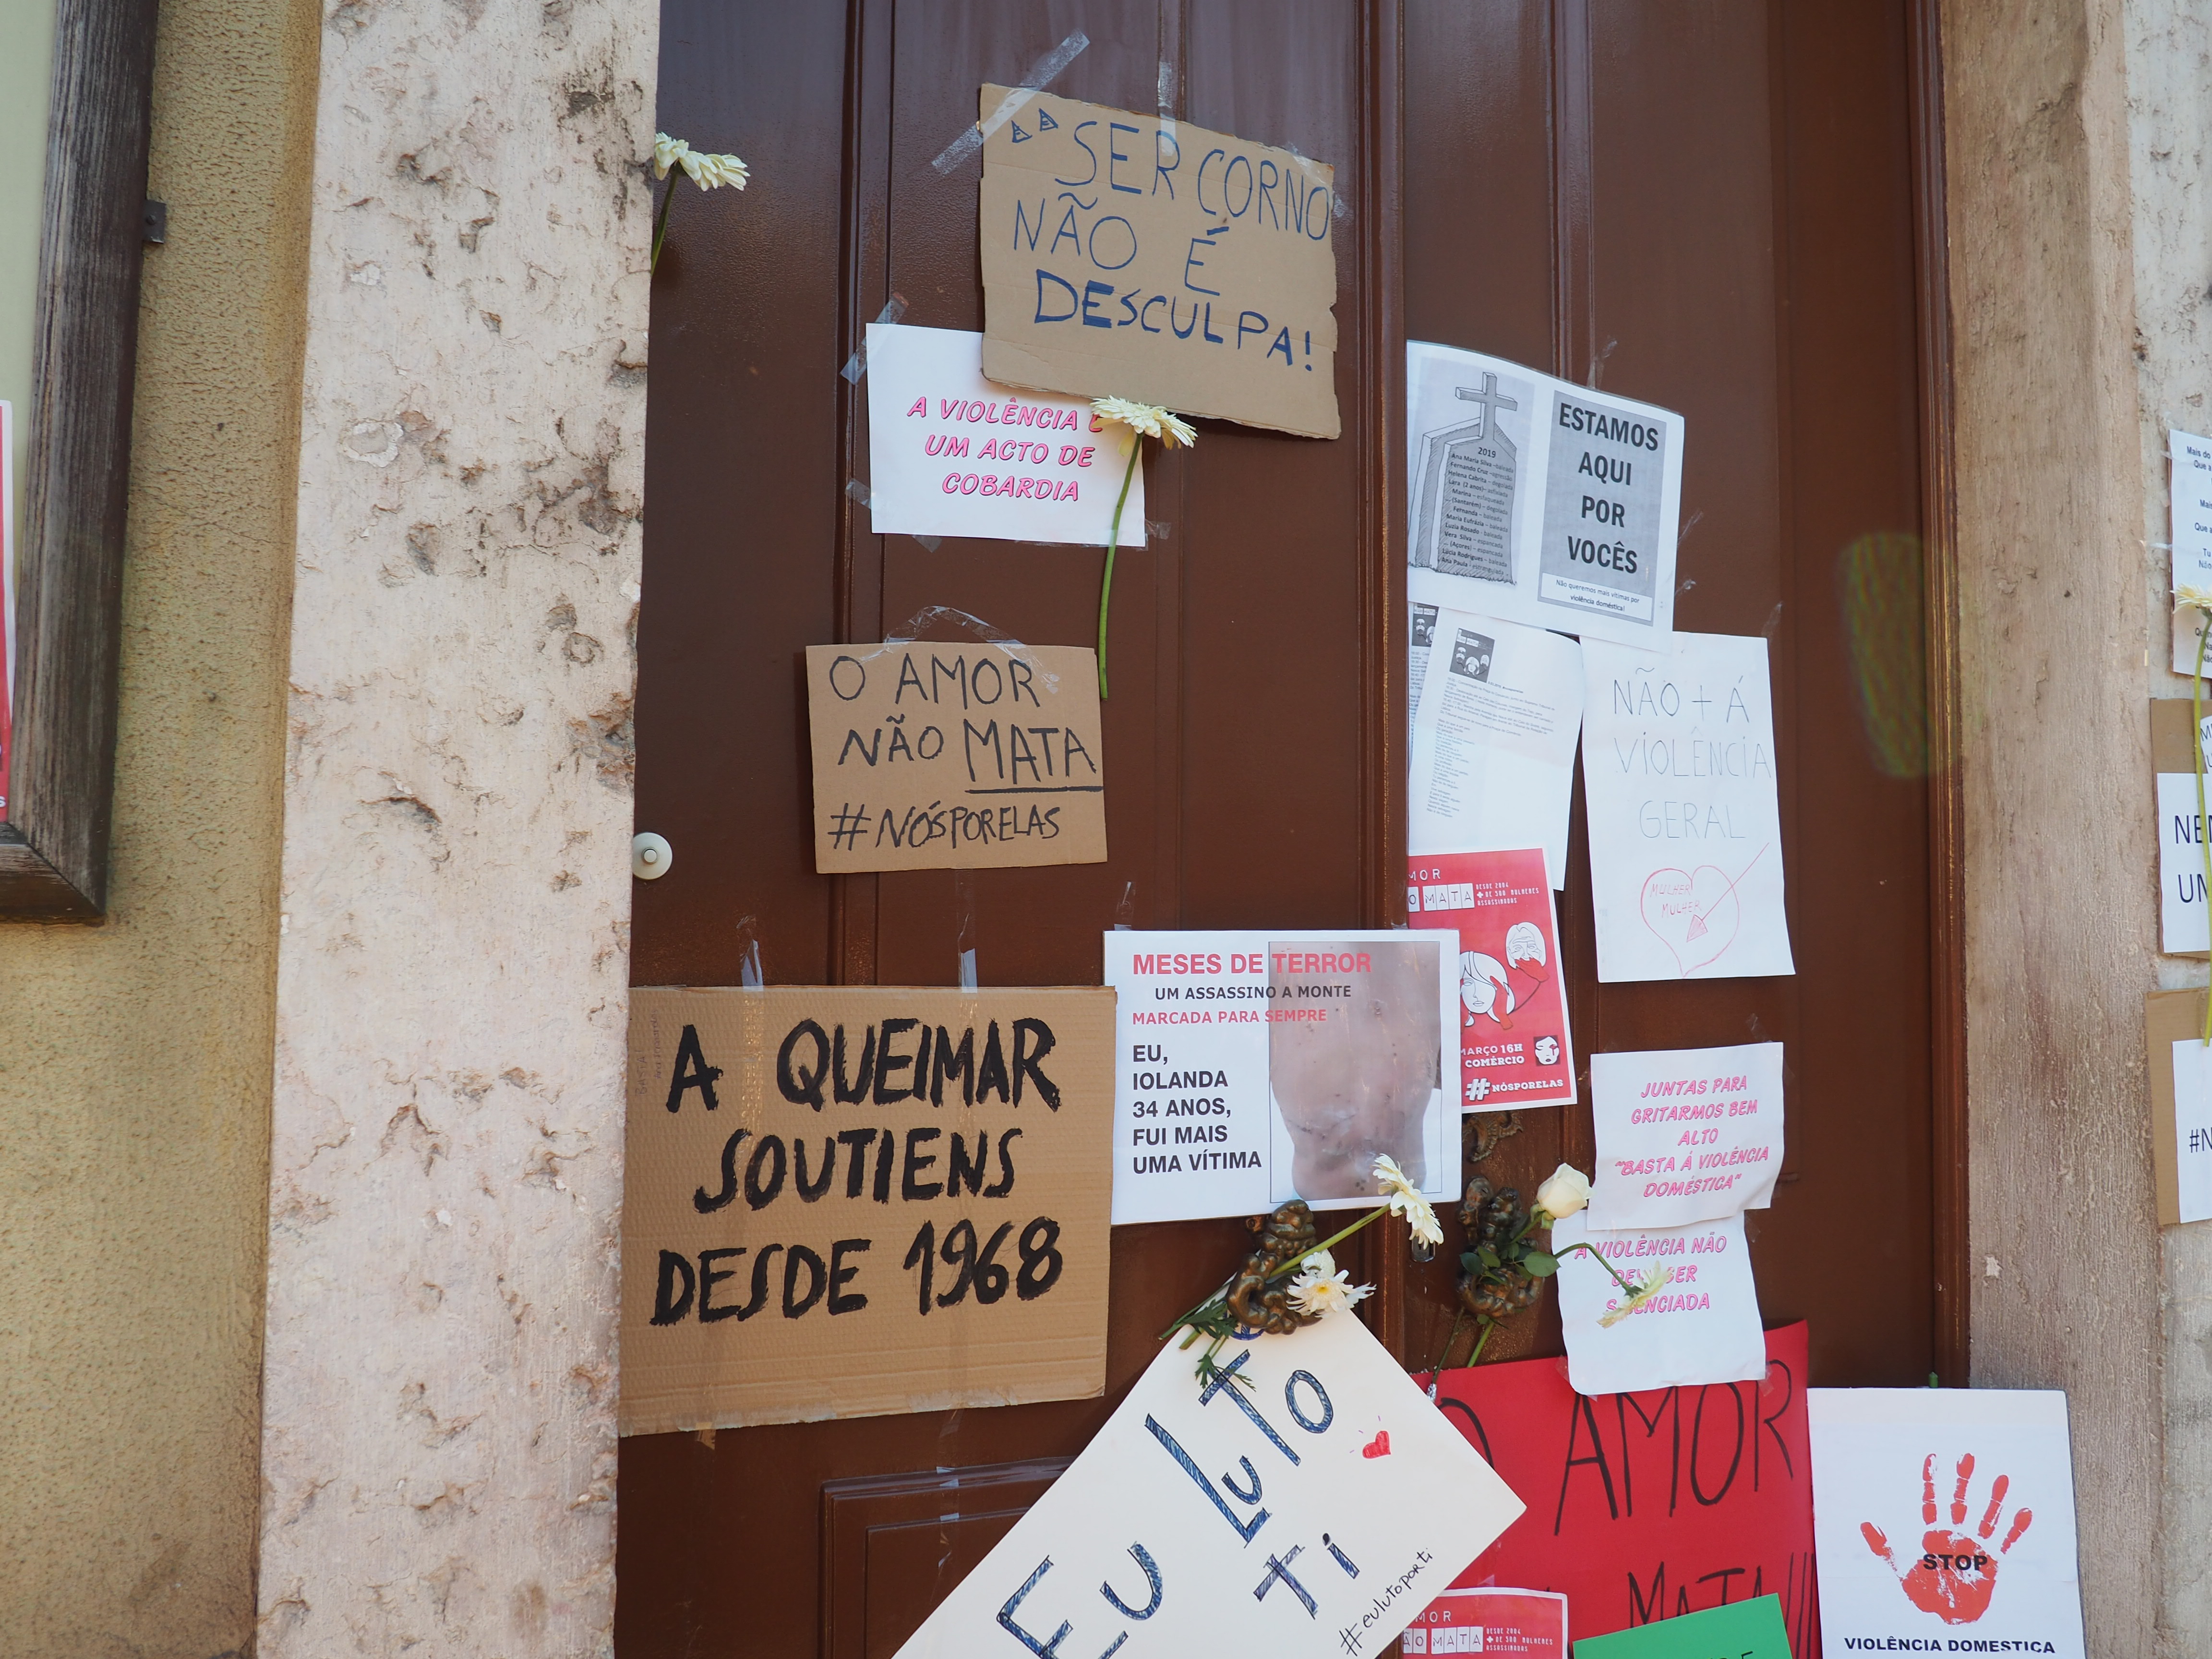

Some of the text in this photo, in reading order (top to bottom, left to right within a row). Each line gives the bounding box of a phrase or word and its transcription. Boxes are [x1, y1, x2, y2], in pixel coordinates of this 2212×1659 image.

[1056, 121, 1334, 240] SER CORNO
[1014, 192, 1230, 296] NÃO É
[1034, 269, 1312, 372] DESCULPA!
[907, 396, 926, 418] A
[940, 397, 1078, 431] VIOLÊNCIA
[1559, 402, 1659, 451] ESTAMOS
[925, 434, 1095, 468] UM ACTO DE
[1464, 456, 1479, 464] Maria
[1478, 447, 1496, 458] 2019
[1448, 470, 1467, 479] Helena
[1578, 452, 1632, 486] AQUI
[942, 472, 1078, 502] COBARDIA
[1446, 514, 1462, 522] Maria
[1581, 495, 1625, 528] POR
[1567, 535, 1637, 574] VOCÊS
[1556, 579, 1567, 588] Não
[1568, 583, 1596, 594] queremos
[1570, 594, 1594, 605] violência
[829, 653, 1040, 710] O AMOR
[1613, 667, 1680, 717] NÃO
[1726, 675, 1750, 723] Á
[838, 713, 1097, 785] NÃO MATA
[827, 800, 1060, 851] #NÓSPORELAS
[1639, 800, 1746, 838] GERAL
[2175, 815, 2212, 844] NE
[1425, 891, 1472, 903] MATA
[1650, 883, 1691, 898] MULHER
[1662, 900, 1702, 918] MULHER
[1133, 952, 1372, 975] MESES DE TERROR
[1154, 985, 1352, 1000] UM ASSASSINO A MONTE
[1132, 1009, 1327, 1025] MARCADA PARA SEMPRE
[1133, 1045, 1168, 1065] EU,
[1500, 1043, 1523, 1054] 16H
[666, 1024, 724, 1113] A
[776, 1017, 1061, 1113] QUEIMAR
[1465, 1056, 1525, 1068] COMÉRCIO
[1133, 1070, 1229, 1090] IOLANDA
[1640, 1075, 1747, 1098] JUNTAS PARA
[1132, 1097, 1231, 1119] 34 ANOS,
[1631, 1099, 1758, 1125] GRITARMOS BEM
[1133, 1125, 1228, 1146] FUI MAIS
[1677, 1128, 1719, 1146] ALTO
[693, 1127, 1024, 1214] SOUTIENS
[1133, 1149, 1262, 1175] UMA VÍTIMA
[1680, 1151, 1693, 1171] Á
[1698, 1145, 1769, 1169] VIOLÊNCIA
[1595, 1234, 1685, 1259] VIOLÊNCIA
[1691, 1231, 1727, 1253] NÃO
[649, 1215, 1063, 1326] DESDE 1968
[1554, 1358, 1794, 1536] AMOR
[1923, 1553, 1988, 1571] STOP
[1433, 1633, 1481, 1647] MATA
[1844, 1636, 2056, 1654] VIOLÊNCIA DOMESTICA
